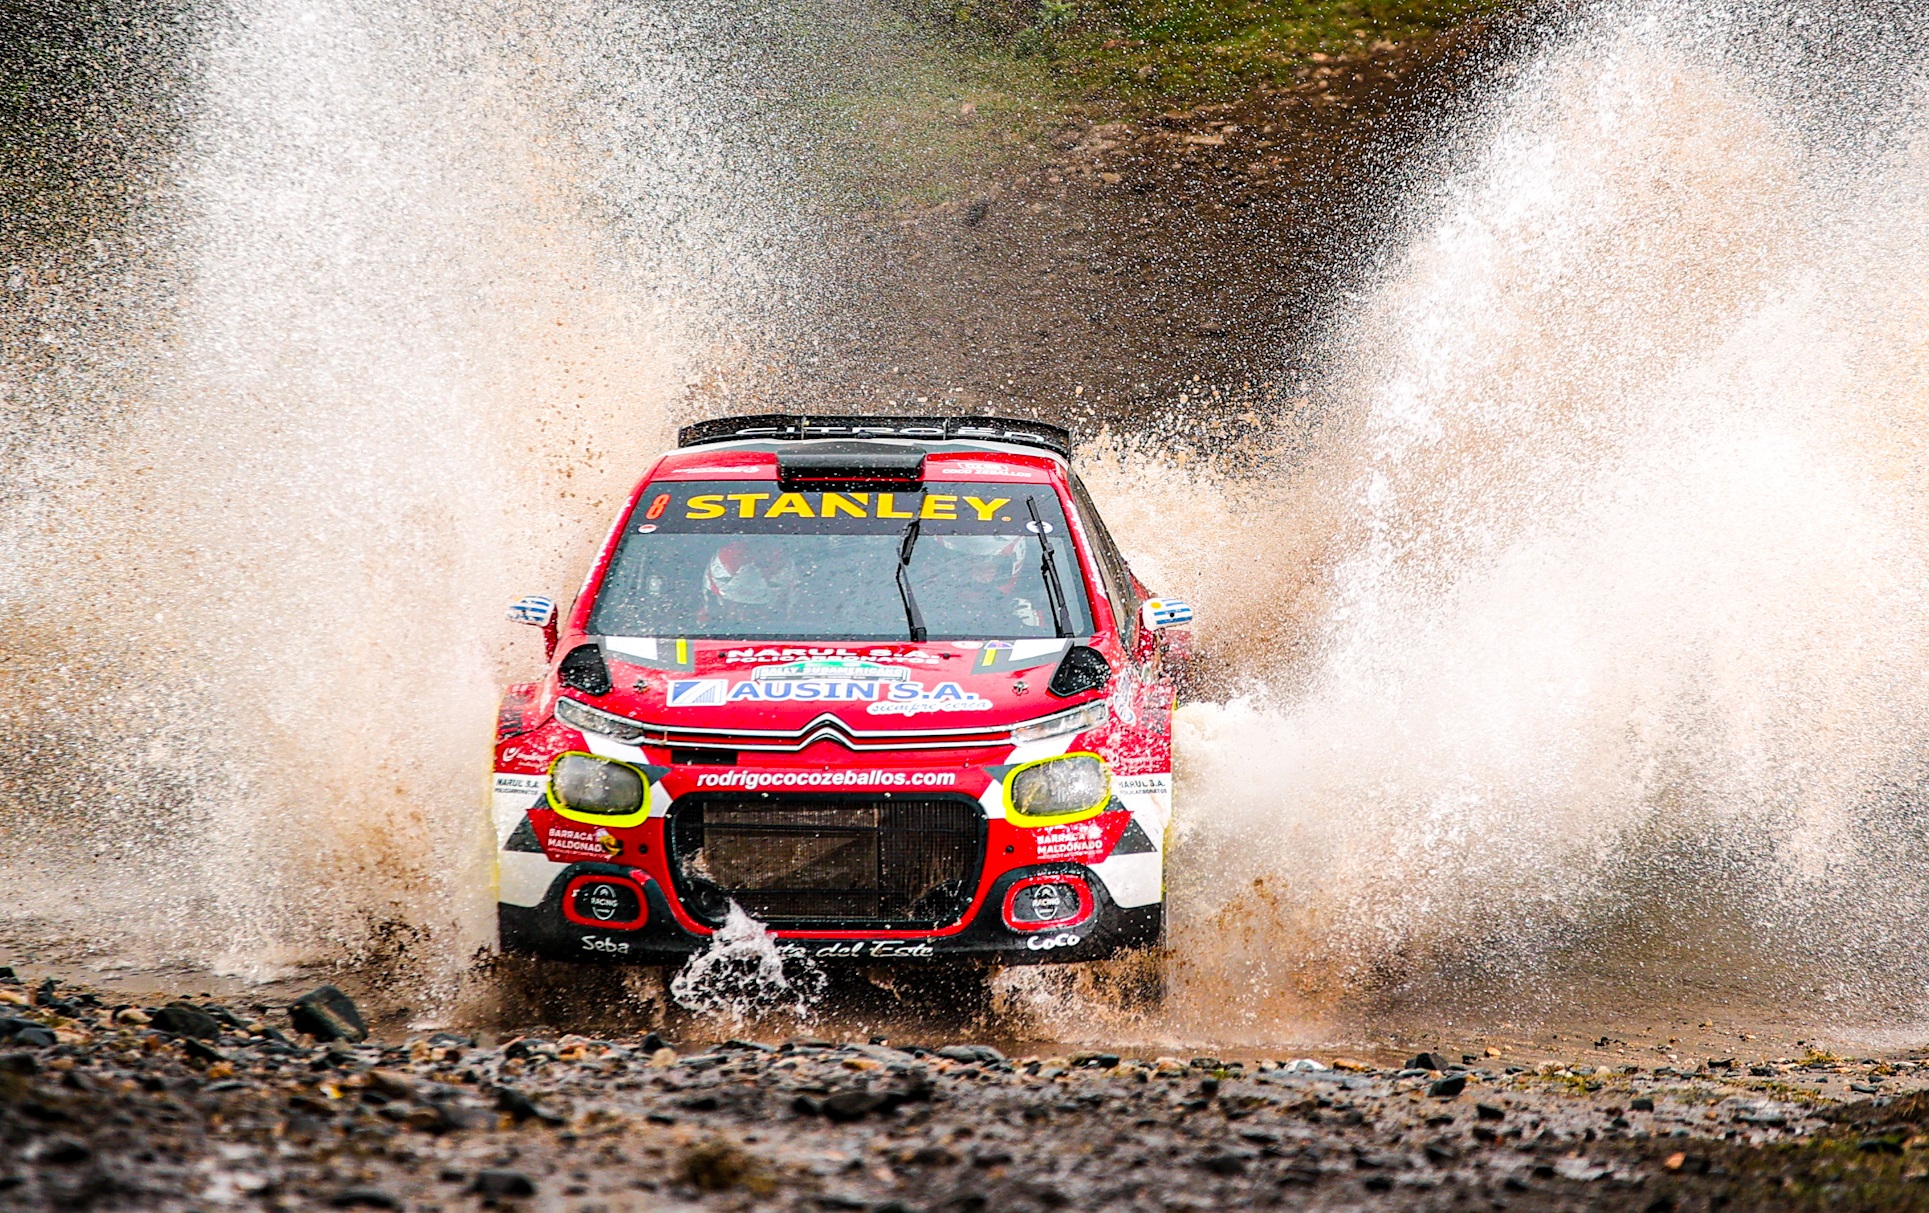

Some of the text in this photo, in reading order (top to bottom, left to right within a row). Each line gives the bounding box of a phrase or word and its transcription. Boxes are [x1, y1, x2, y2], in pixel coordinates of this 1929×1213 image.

[645, 493, 671, 519] 8
[727, 648, 940, 659] NARUL S.A.
[731, 682, 974, 699] AUSIN S.A.
[871, 701, 987, 714] siempre cerca
[697, 770, 956, 789] rodrigococozeballos.com
[548, 828, 594, 841] BARRACA
[1037, 840, 1103, 854] MALDONADO
[590, 896, 619, 907] RACING
[1032, 897, 1060, 907] RACING
[581, 935, 630, 954] Seba
[815, 942, 865, 957] del
